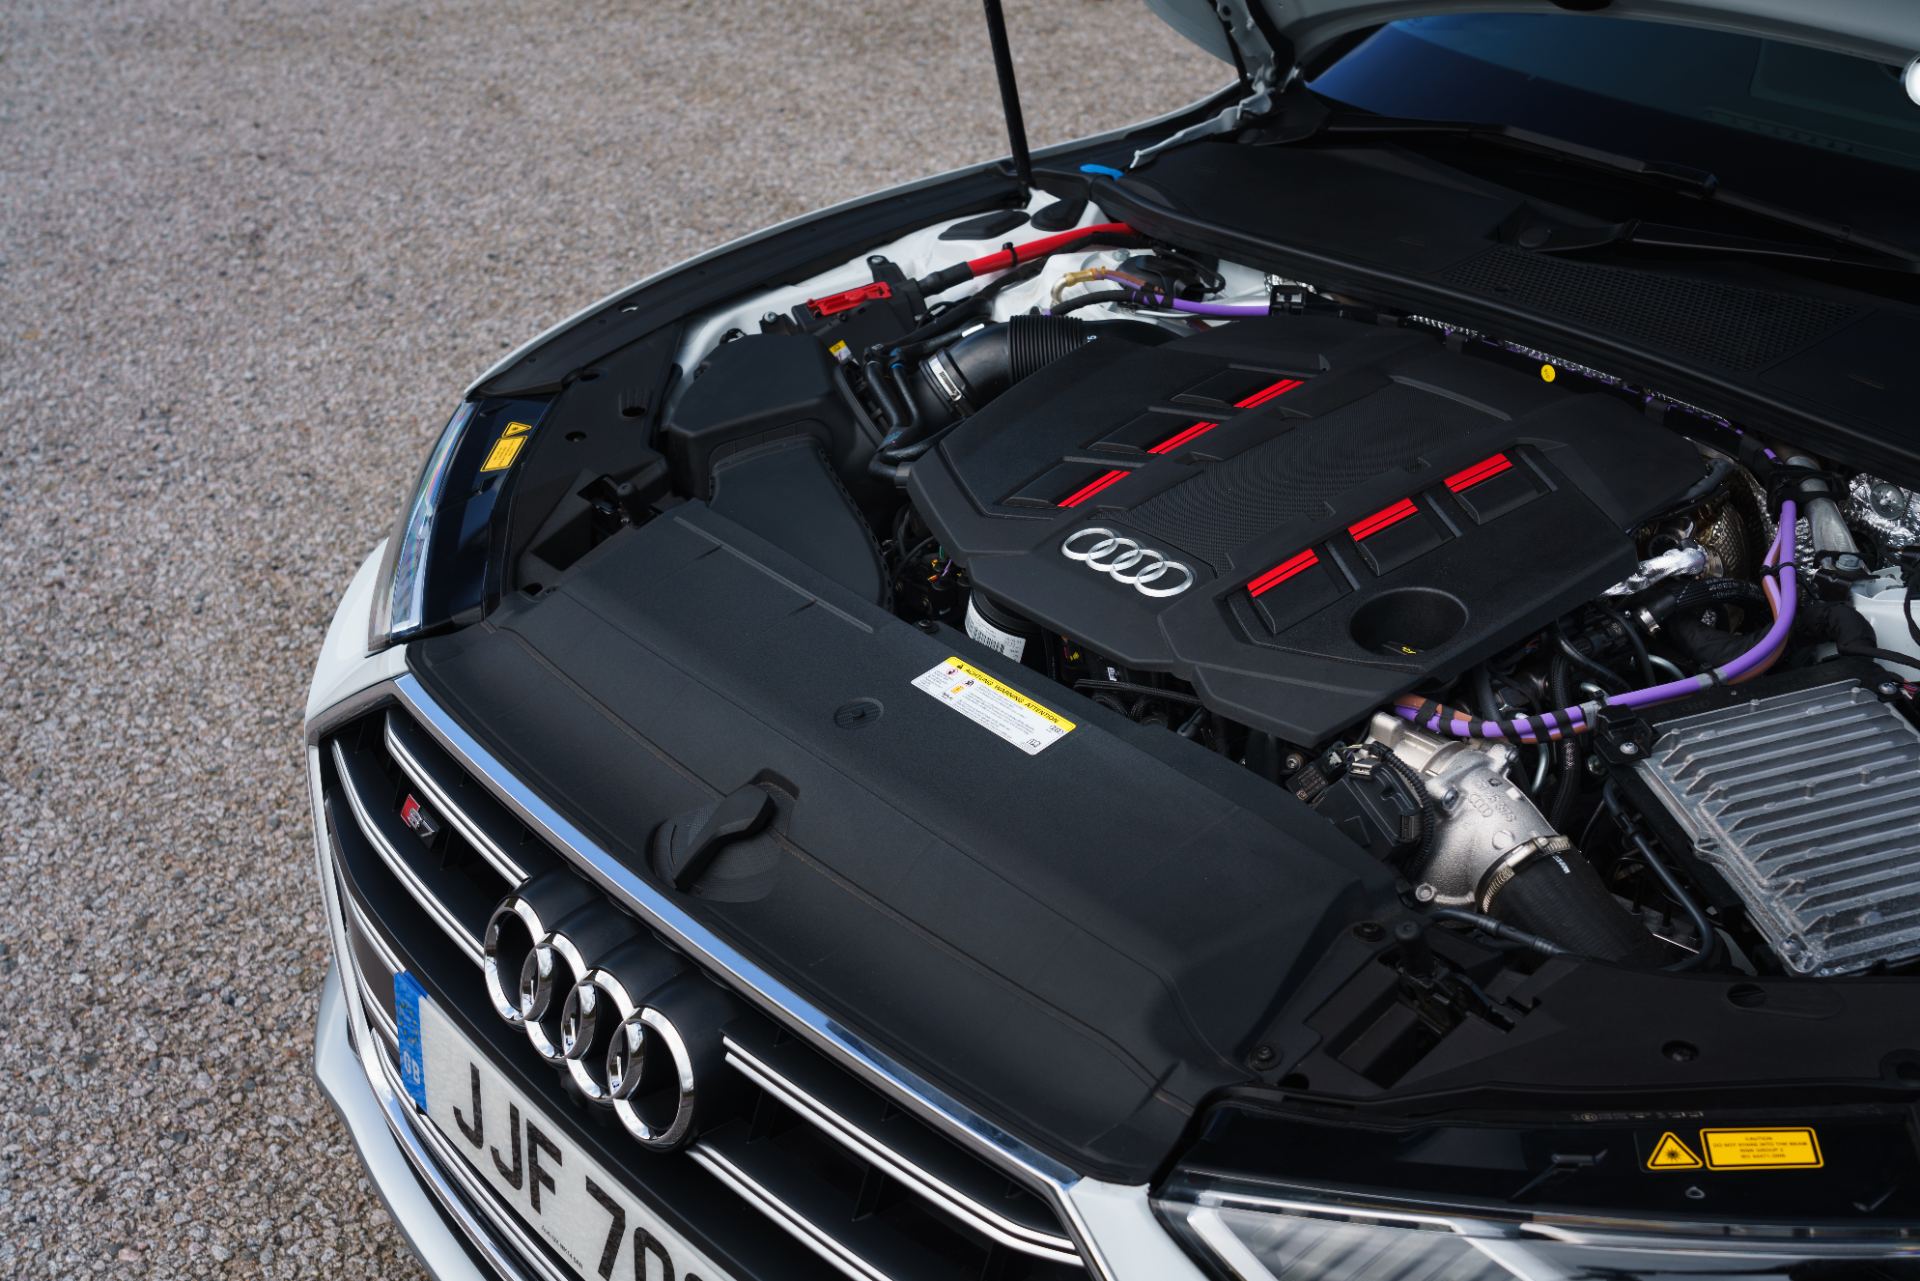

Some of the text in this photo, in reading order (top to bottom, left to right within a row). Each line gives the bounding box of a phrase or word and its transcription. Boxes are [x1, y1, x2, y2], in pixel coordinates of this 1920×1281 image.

[965, 668, 994, 686] ACHTUNG
[994, 684, 1025, 703] WARNING
[1025, 702, 1059, 724] ATTENTION
[403, 1050, 421, 1085] GB
